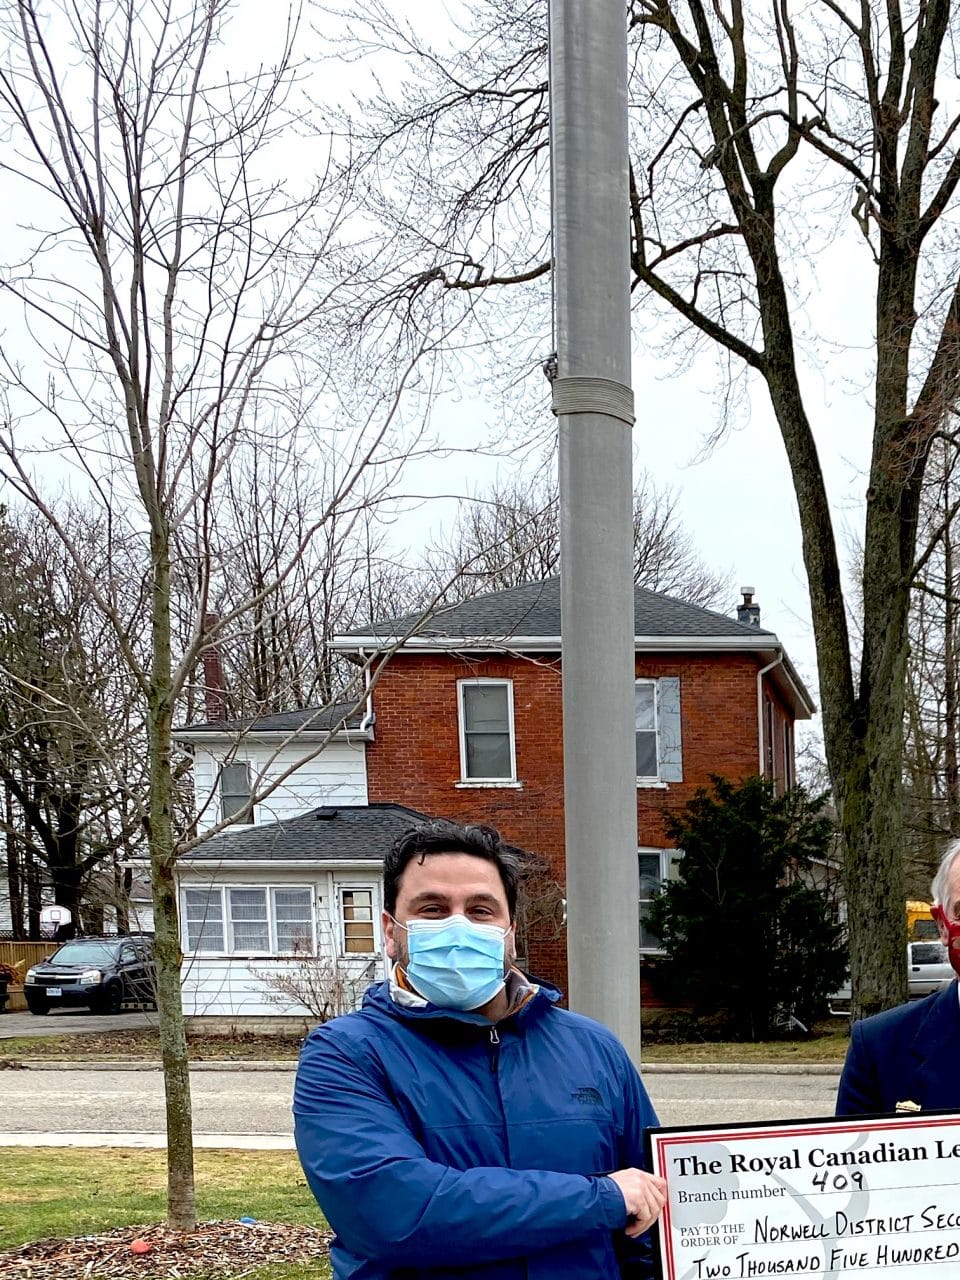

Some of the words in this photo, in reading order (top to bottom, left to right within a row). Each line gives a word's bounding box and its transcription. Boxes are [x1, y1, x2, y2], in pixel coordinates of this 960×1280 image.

[674, 1156, 722, 1177] The
[730, 1149, 801, 1175] Royal
[808, 1140, 928, 1168] Canadian
[812, 1171, 864, 1192] 409
[678, 1189, 727, 1203] Branch
[732, 1185, 786, 1200] number
[681, 1226, 702, 1237] PAY
[704, 1225, 719, 1236] TO
[722, 1223, 745, 1234] THE
[754, 1216, 830, 1243] NORWELL
[835, 1212, 915, 1237] DISTRICT
[681, 1238, 720, 1248] ORDER
[723, 1236, 739, 1245] OF
[692, 1257, 731, 1280] TWO
[736, 1252, 821, 1275] THOUSAND
[829, 1248, 869, 1271] FIVE
[876, 1242, 960, 1265] HUNDRED
